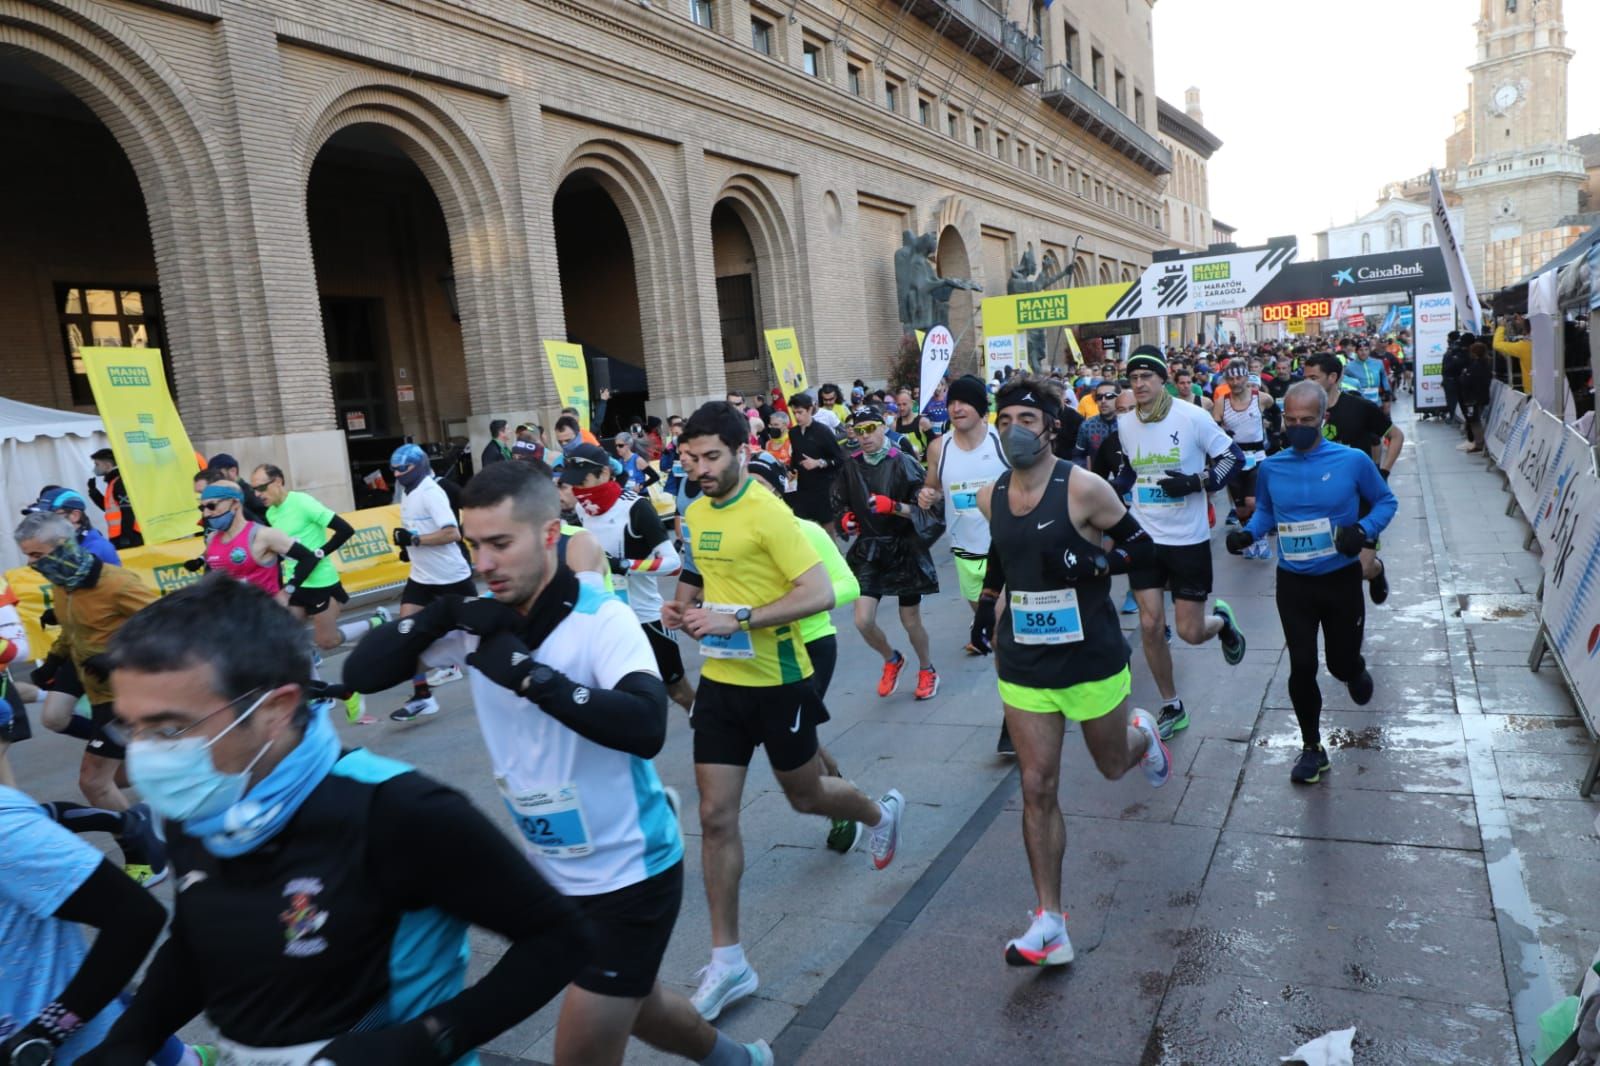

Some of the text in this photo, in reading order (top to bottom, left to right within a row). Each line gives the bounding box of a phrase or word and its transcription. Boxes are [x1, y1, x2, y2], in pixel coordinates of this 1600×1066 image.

[1194, 263, 1229, 273] MANN
[1357, 262, 1424, 280] CaixaBank
[1194, 270, 1229, 281] FILTER
[1205, 287, 1247, 297] ZARAGOZA
[1019, 296, 1065, 311] MANN
[1420, 297, 1450, 309] HOKA
[1020, 307, 1066, 322] FILTER
[931, 333, 949, 345] 42K
[989, 339, 1011, 348] HOKA
[110, 368, 146, 377] MANN
[112, 377, 149, 385] FILTER
[1292, 536, 1313, 548] 771
[340, 540, 391, 561] FILTER
[1026, 612, 1057, 627] 586
